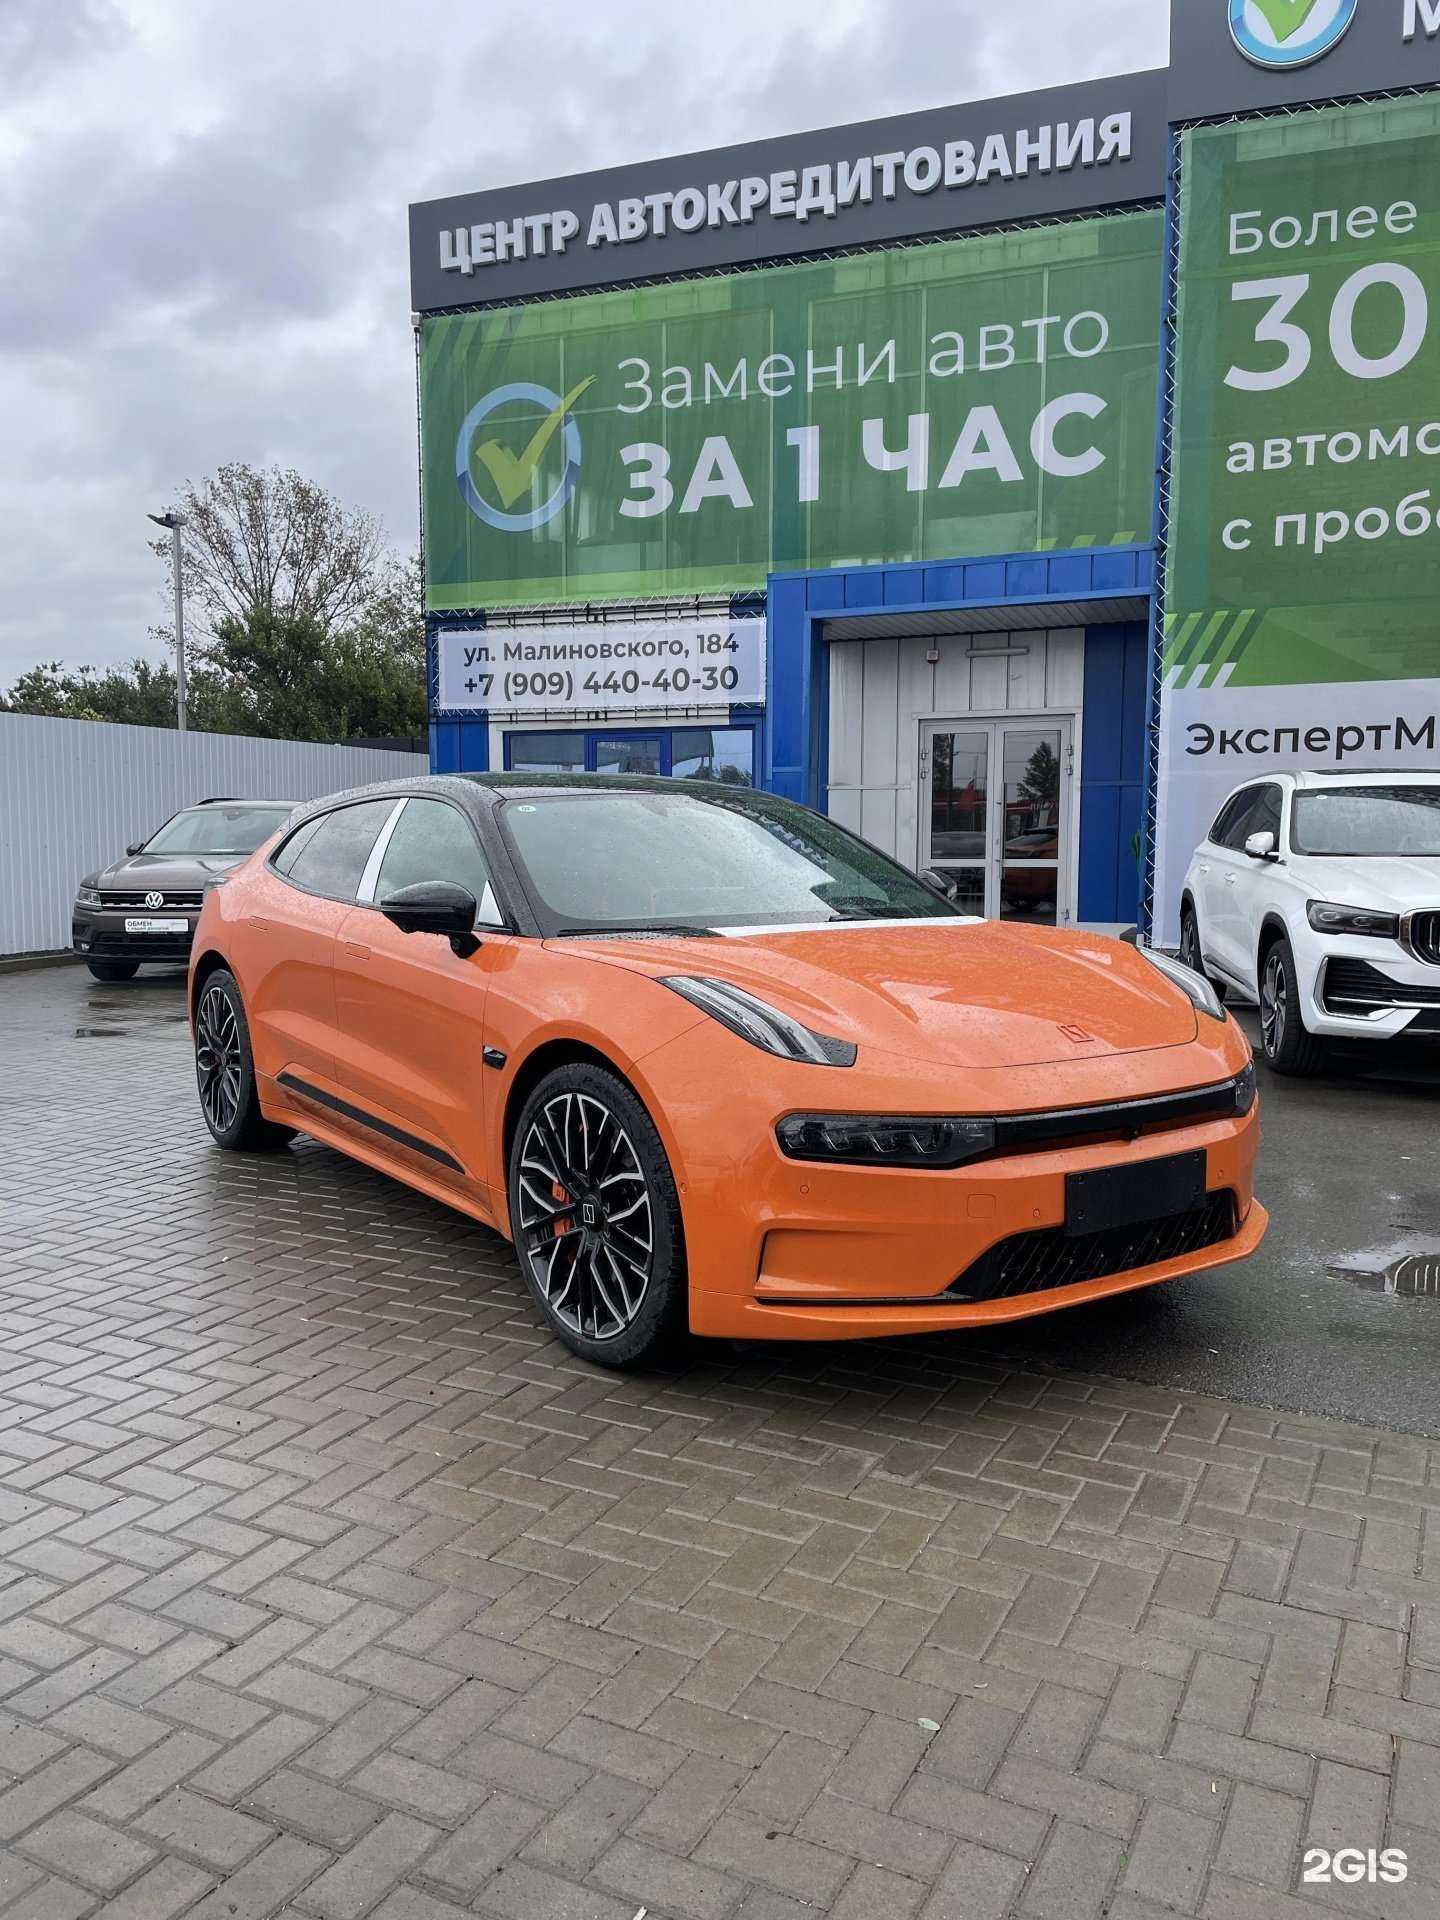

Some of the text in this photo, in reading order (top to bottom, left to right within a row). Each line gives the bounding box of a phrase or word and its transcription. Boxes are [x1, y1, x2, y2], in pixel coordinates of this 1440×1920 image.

[439, 111, 1132, 275] ЦЕНТР АВТОКРЕДИТОВАНИЯ
[1229, 200, 1417, 255] Более
[1223, 262, 1428, 391] 30
[617, 311, 1109, 413] Замени авто
[618, 392, 1108, 518] ЗА 1 ЧАС
[1226, 422, 1440, 473] автомо
[1222, 489, 1440, 554] с проб
[463, 633, 739, 667] ул. Малиновского, 184
[464, 665, 739, 701] +7 (909) 440-40-30
[1184, 715, 1435, 761] ЭкспертМ
